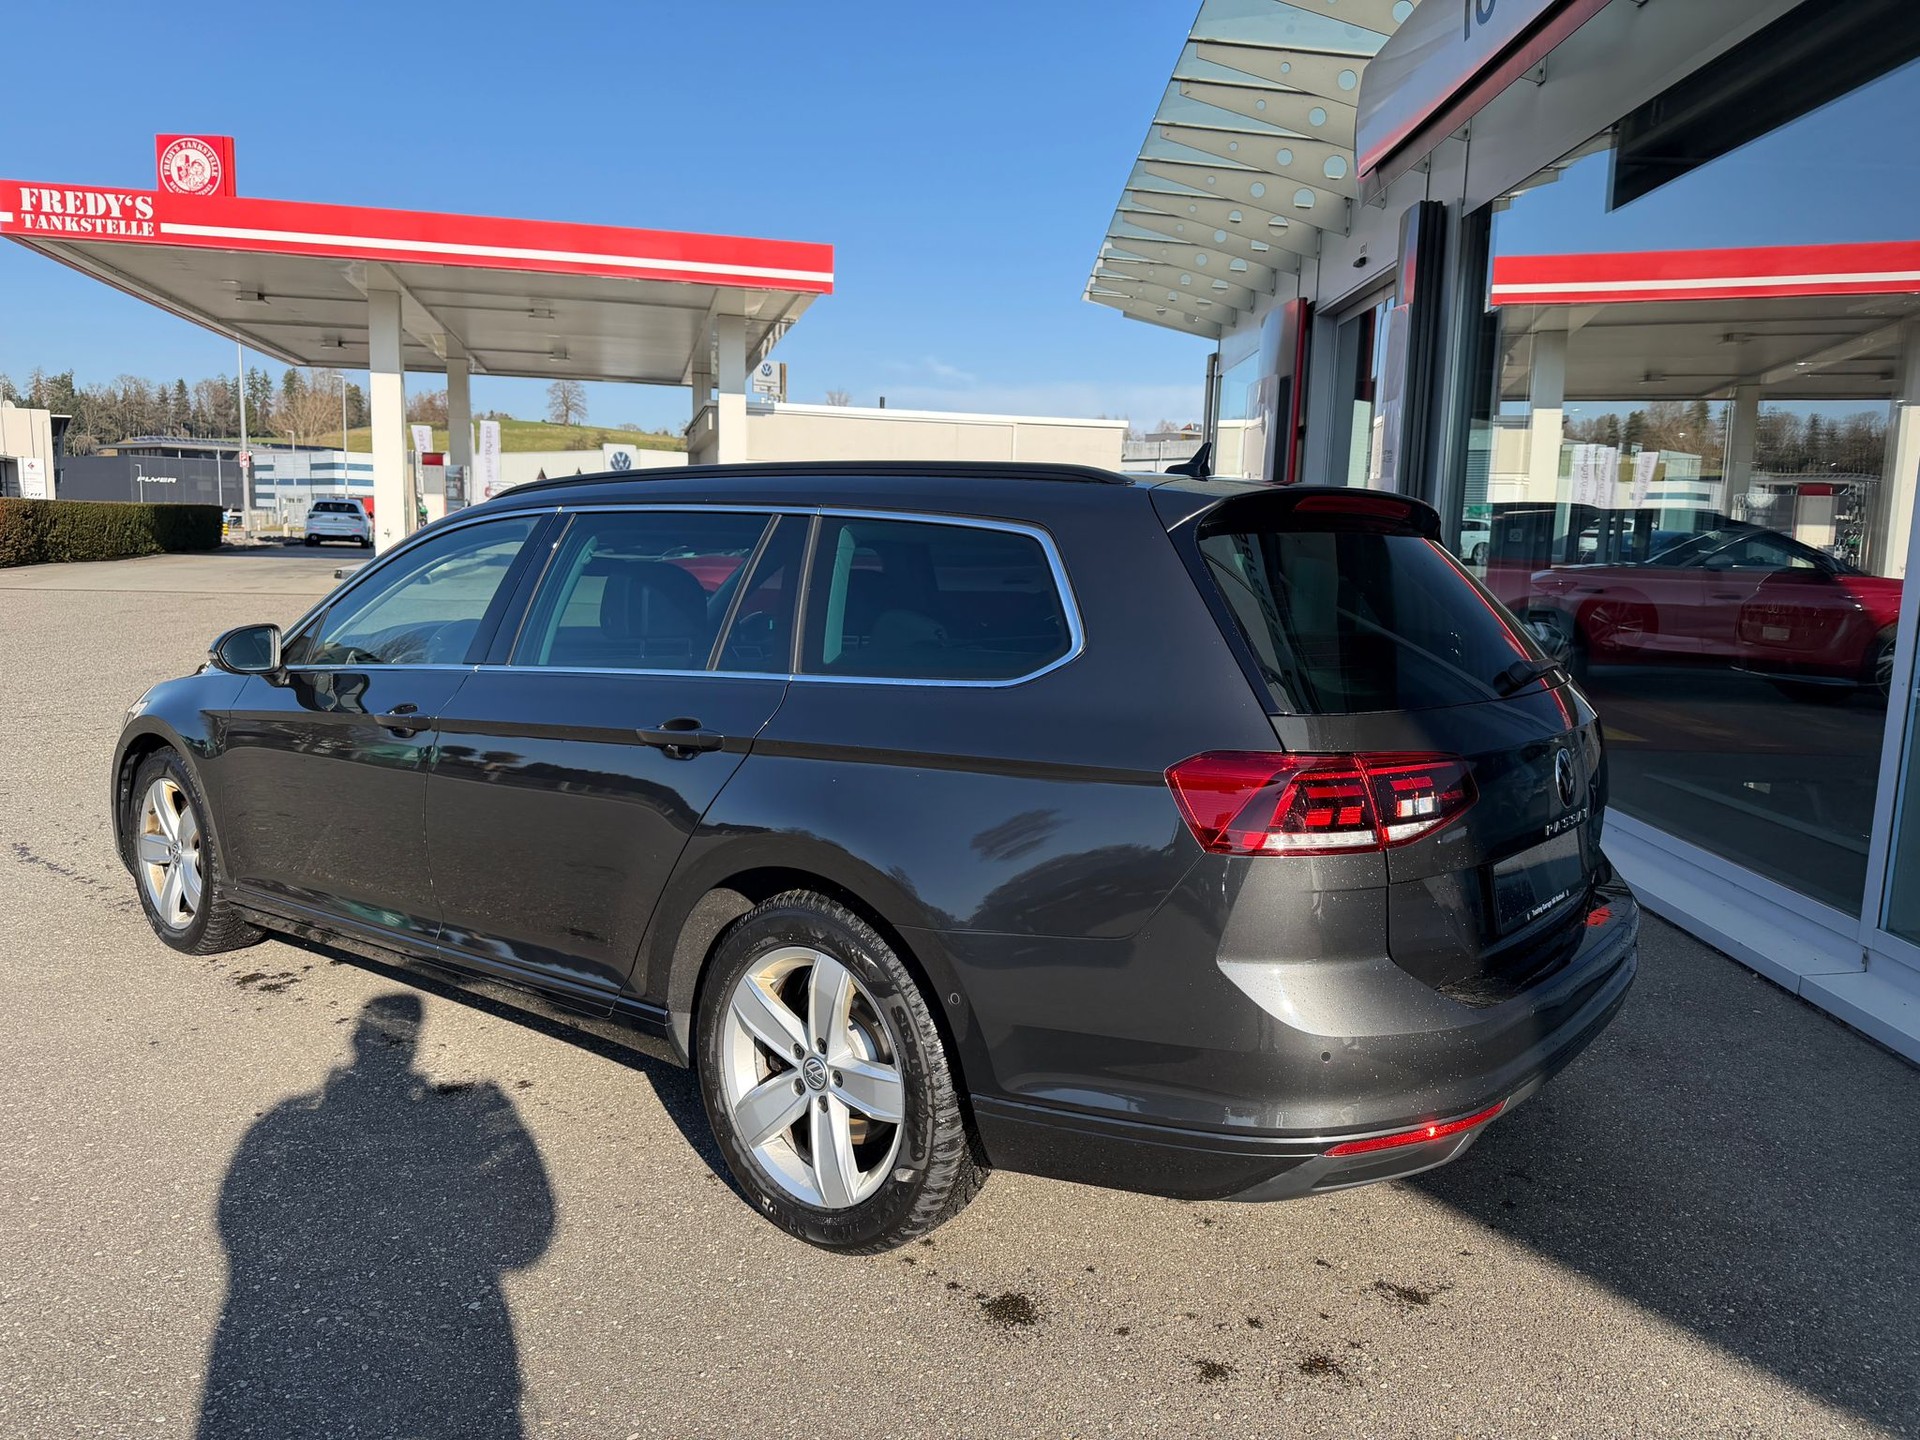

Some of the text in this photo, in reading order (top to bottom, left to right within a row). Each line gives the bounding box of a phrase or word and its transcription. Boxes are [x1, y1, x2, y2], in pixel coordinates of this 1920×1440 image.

[19, 187, 154, 220] FREDY'S
[20, 213, 155, 237] TANKSTELLE
[136, 476, 177, 484] FLYER
[1544, 807, 1589, 836] PASSAT
